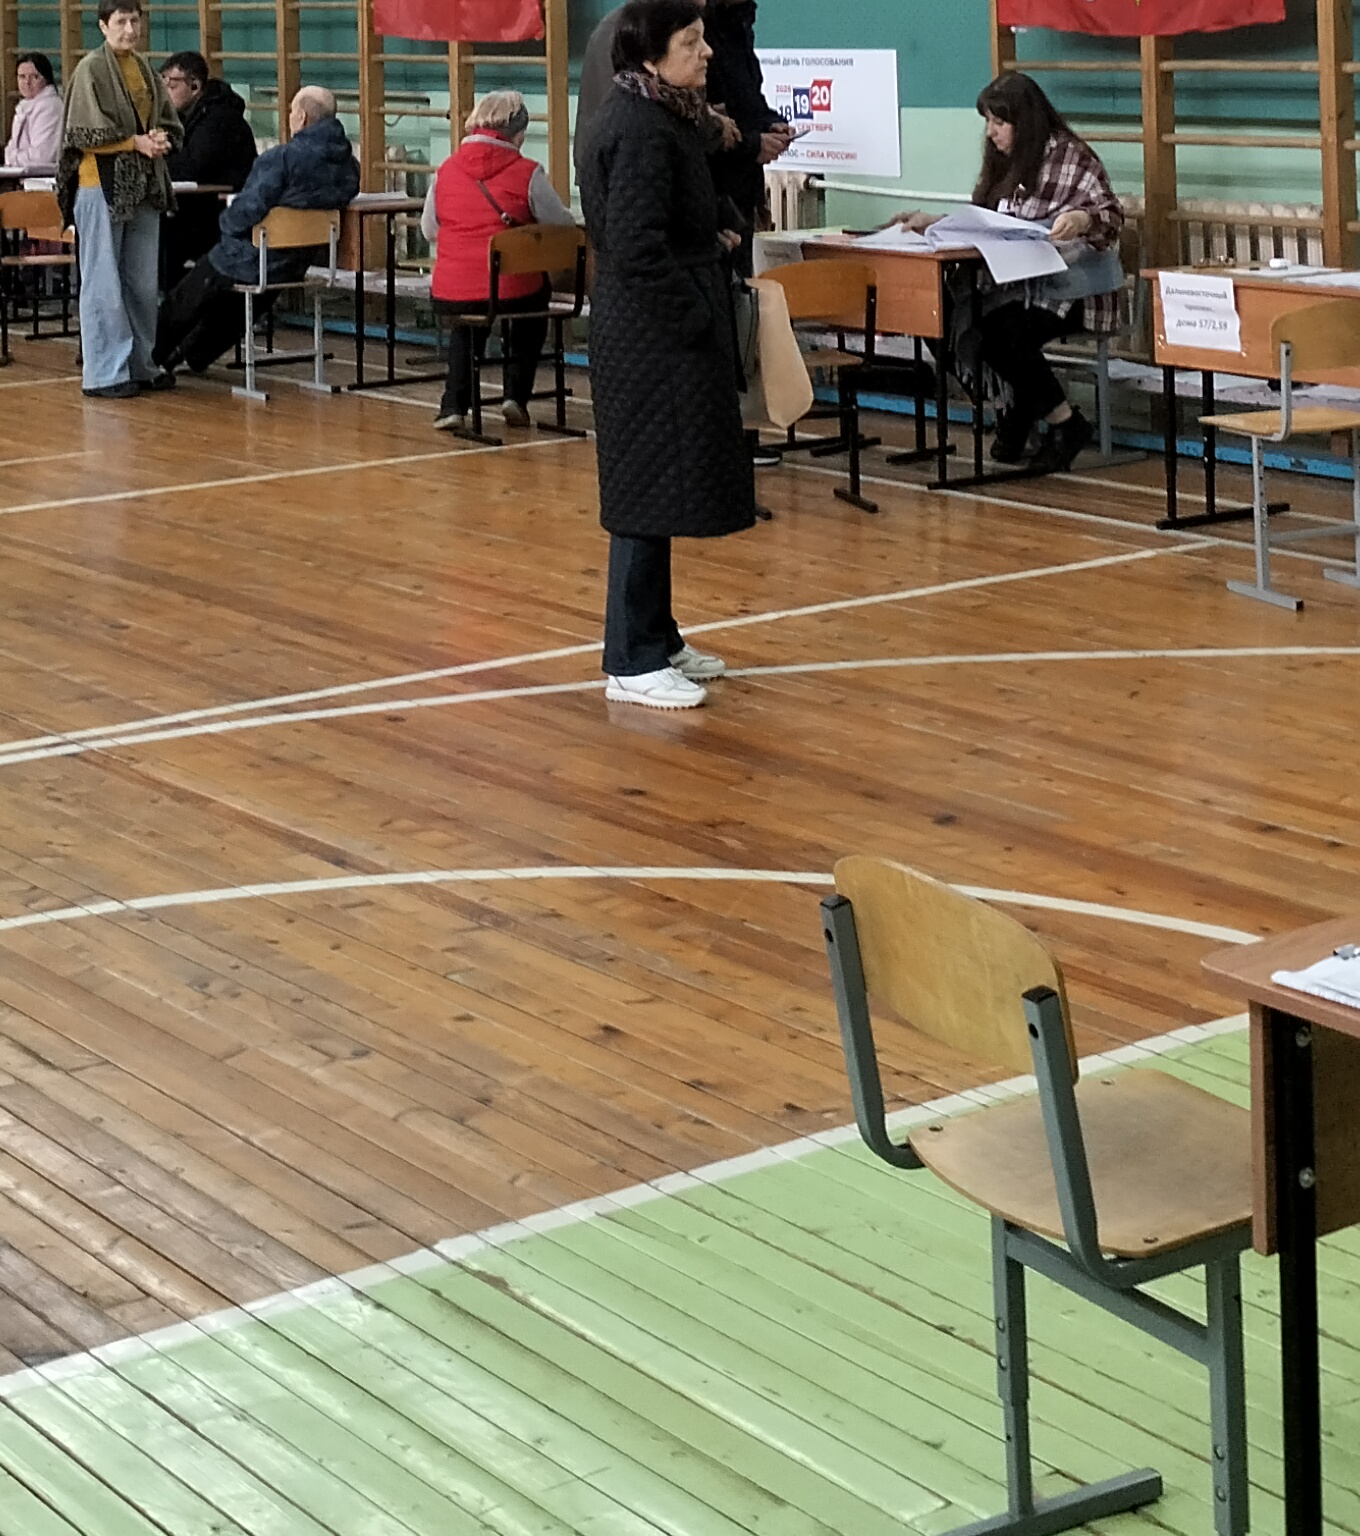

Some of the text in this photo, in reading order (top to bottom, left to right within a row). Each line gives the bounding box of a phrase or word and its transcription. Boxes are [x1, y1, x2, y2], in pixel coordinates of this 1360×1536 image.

[782, 57, 800, 67] ДЕНЬ
[802, 57, 853, 67] ГОЛОСОВАНИЯ
[779, 86, 829, 123] 18 19 20
[806, 150, 824, 159] СИЛА
